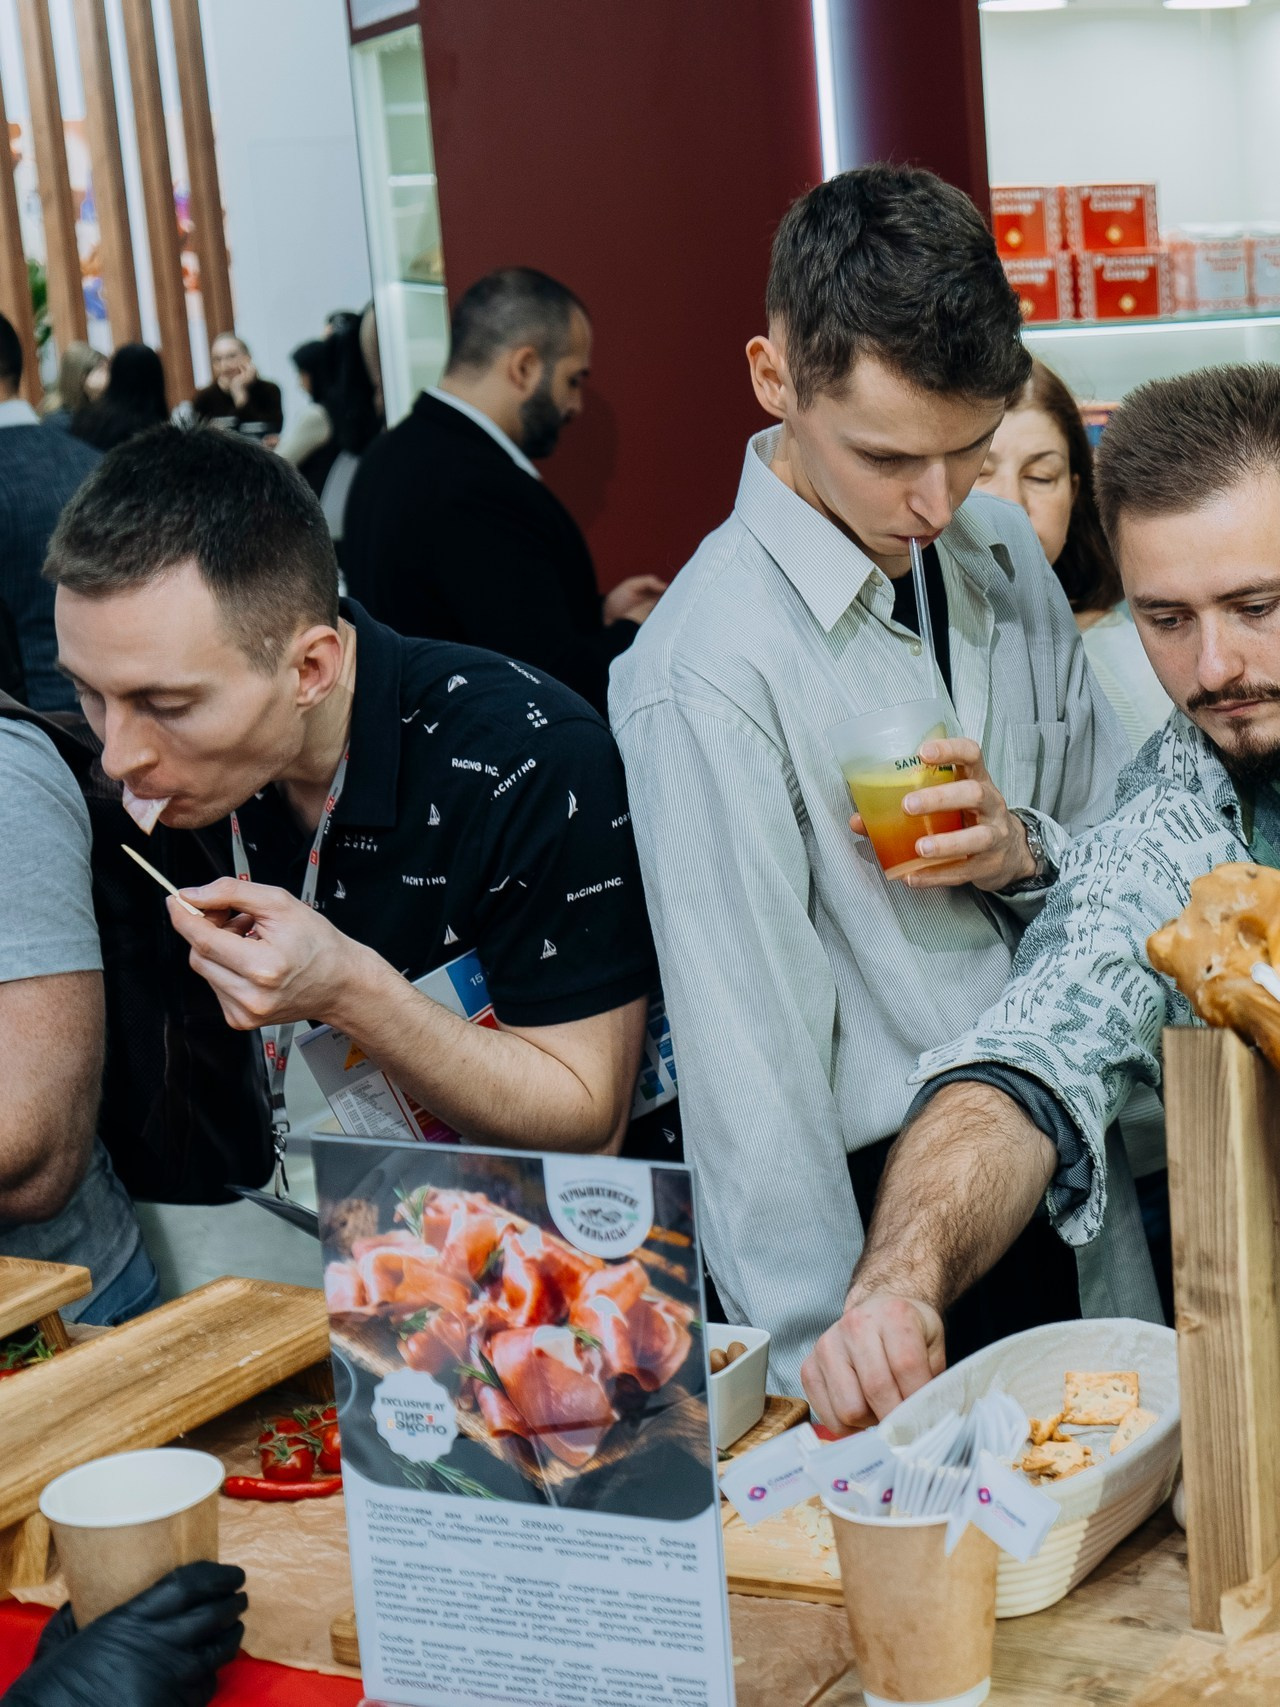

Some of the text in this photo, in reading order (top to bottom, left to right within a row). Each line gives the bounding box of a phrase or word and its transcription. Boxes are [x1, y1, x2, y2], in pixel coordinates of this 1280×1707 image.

[452, 757, 500, 777] RACING INC.
[894, 755, 922, 771] SANT
[491, 758, 537, 800] ACHTING
[402, 874, 447, 886] YACHTING
[566, 876, 624, 902] RACING INC.
[381, 1397, 446, 1411] EXCLUSIVE AT
